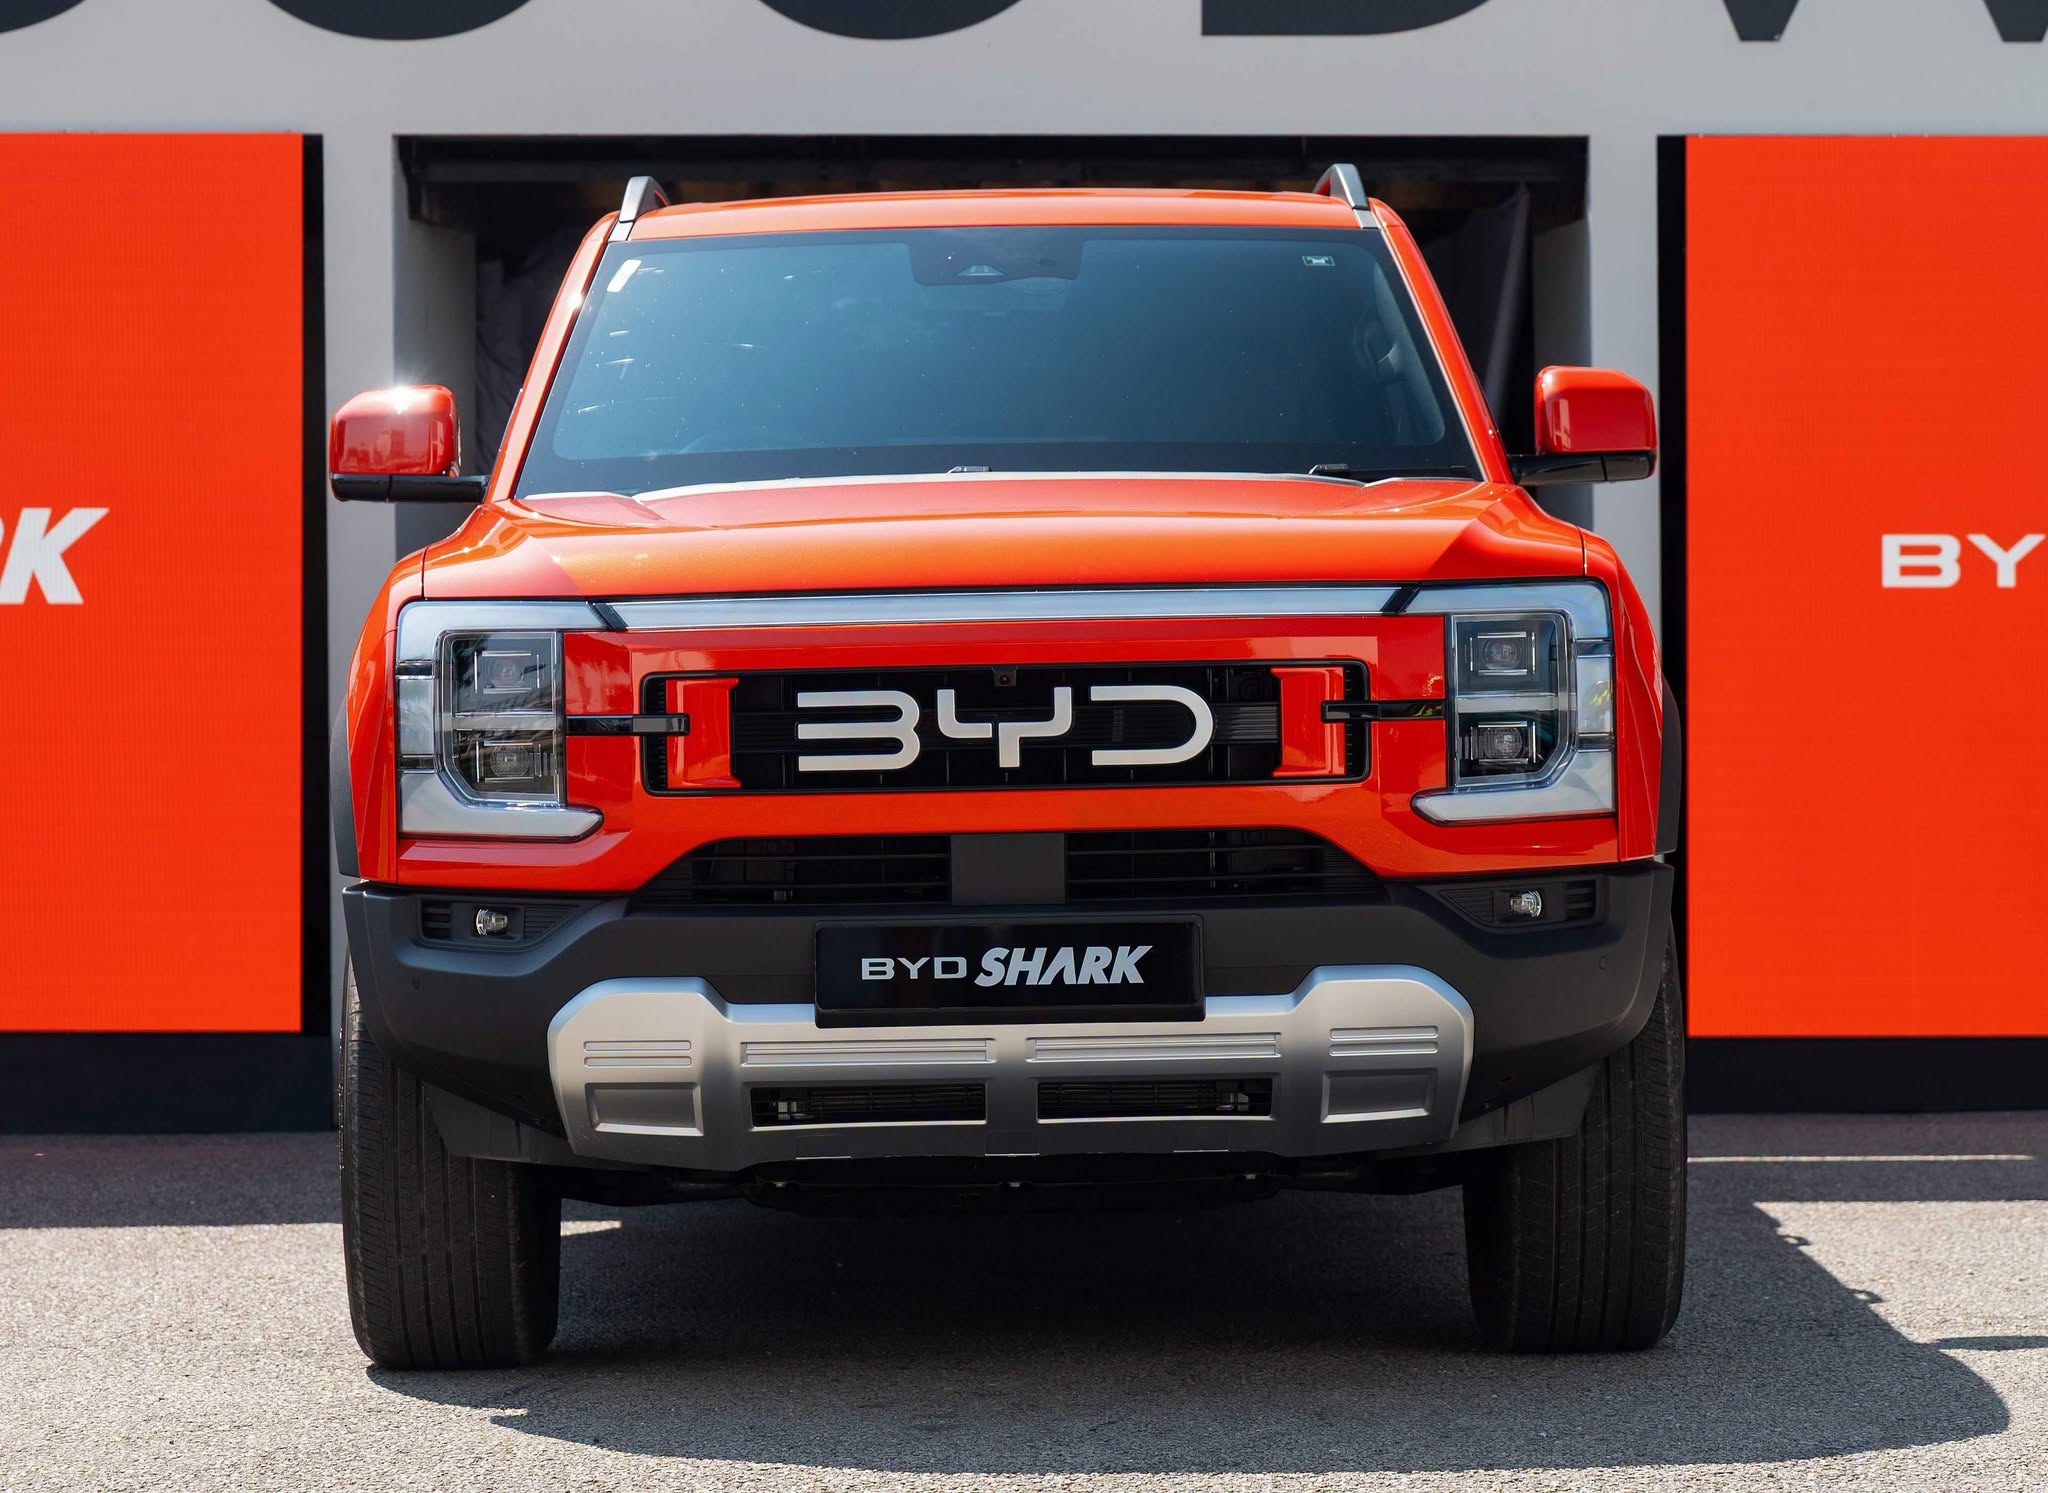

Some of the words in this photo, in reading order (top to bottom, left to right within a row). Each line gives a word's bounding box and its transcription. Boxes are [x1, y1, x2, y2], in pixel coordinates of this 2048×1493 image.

[0, 507, 110, 605] K
[797, 685, 1214, 772] BYD
[861, 956, 967, 980] BYD
[974, 945, 1153, 987] SHARK
